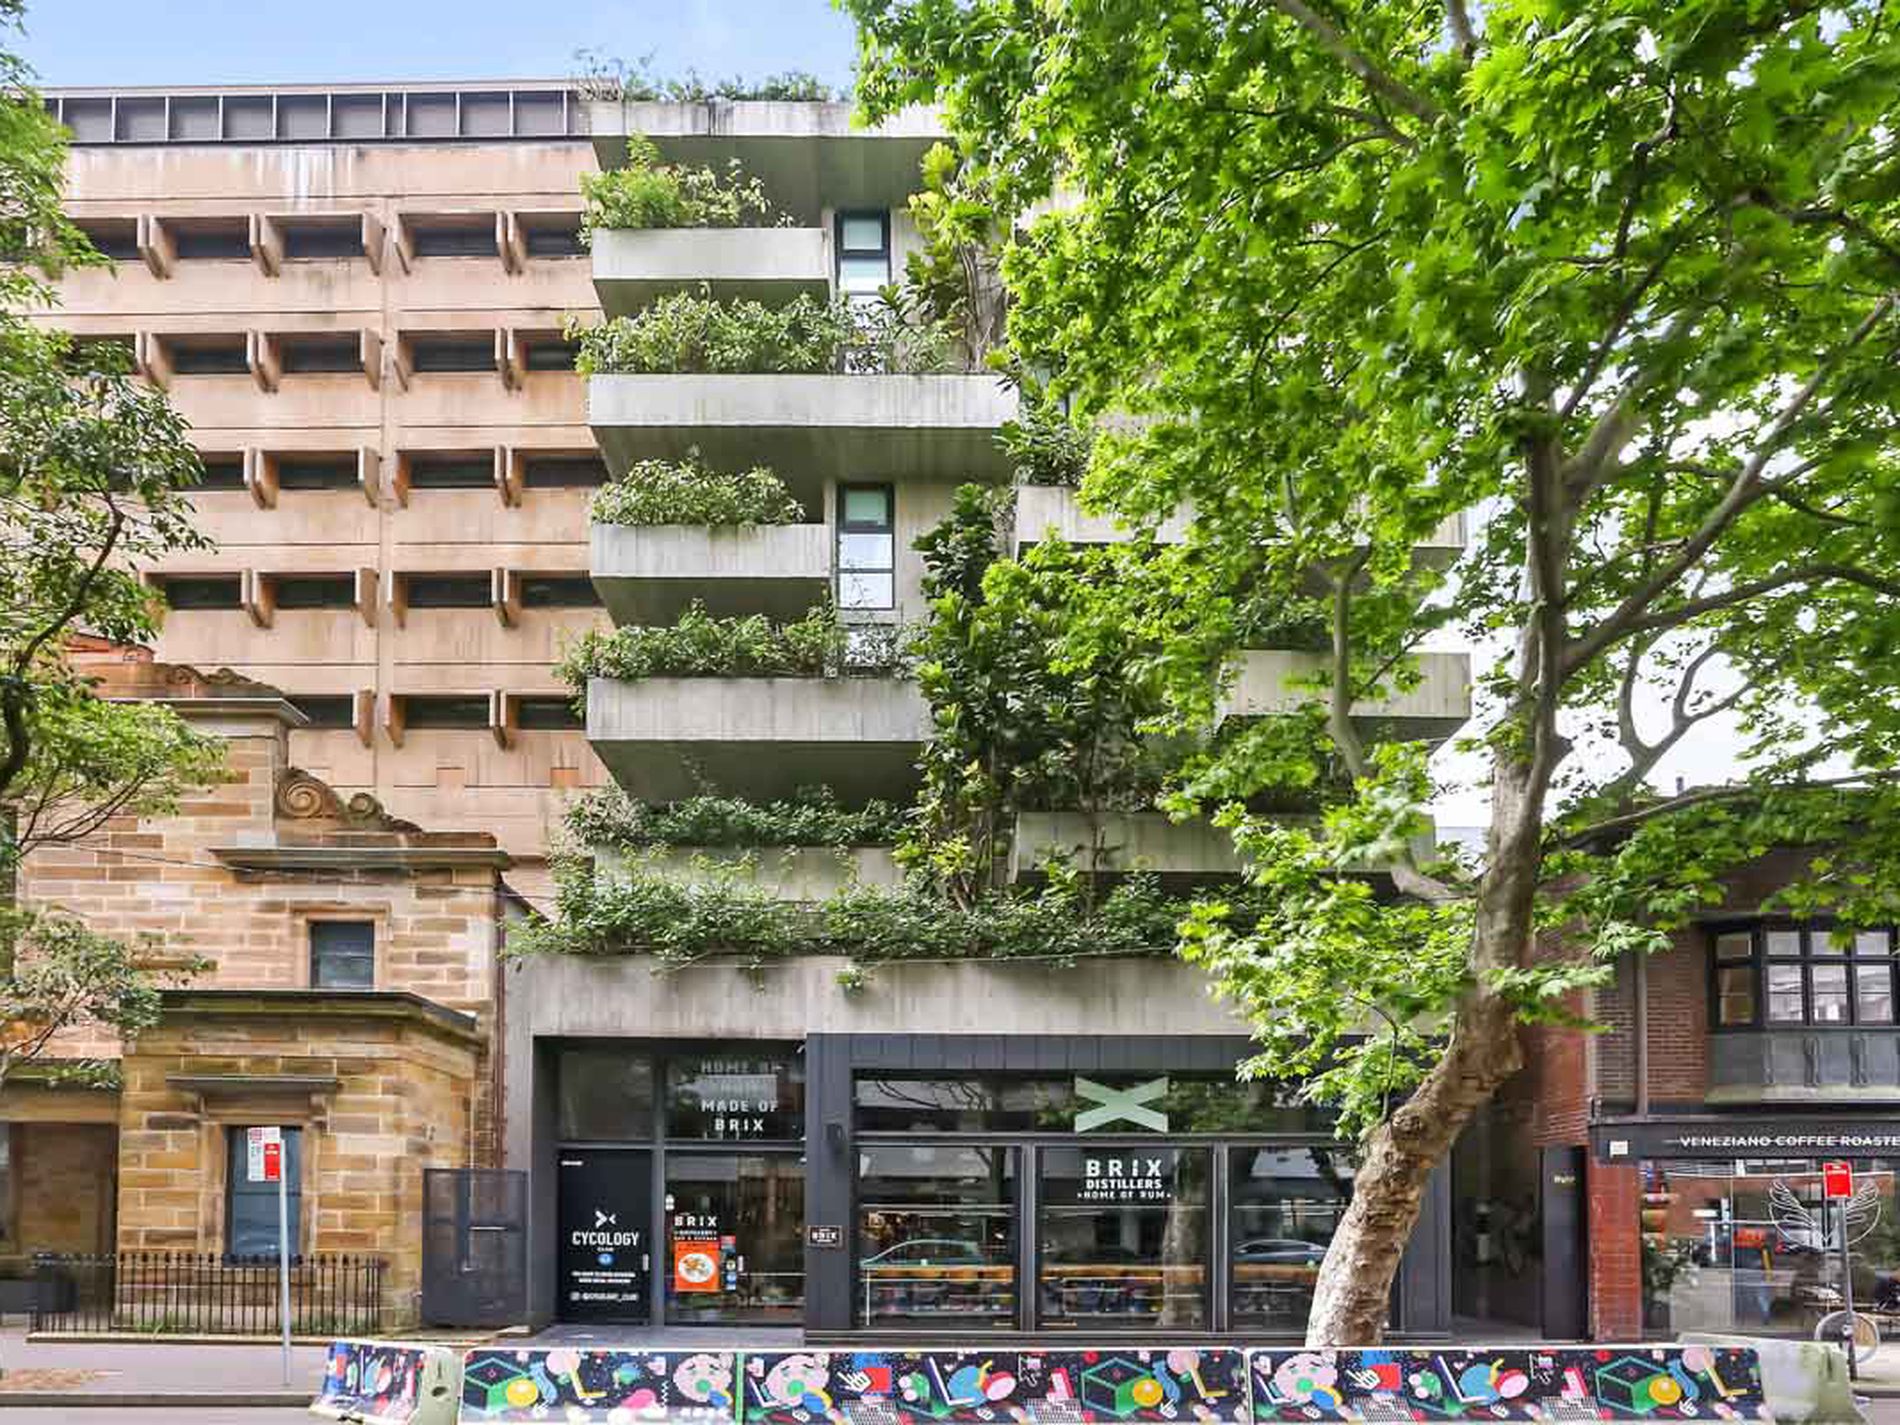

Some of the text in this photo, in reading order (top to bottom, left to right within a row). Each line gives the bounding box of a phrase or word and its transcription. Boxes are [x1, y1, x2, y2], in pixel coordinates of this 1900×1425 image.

[701, 1100, 779, 1112] MADE OF
[714, 1118, 764, 1131] BRIX
[1680, 1136, 1771, 1146] VENEZIANO
[1775, 1136, 1836, 1146] COFFEE
[1086, 1159, 1162, 1177] BRIX
[1086, 1179, 1162, 1190] DISTILLERS
[1083, 1191, 1115, 1199] HOME
[1139, 1191, 1165, 1199] RUM
[674, 1215, 718, 1227] BRIX
[572, 1231, 639, 1246] CYCOLOGY
